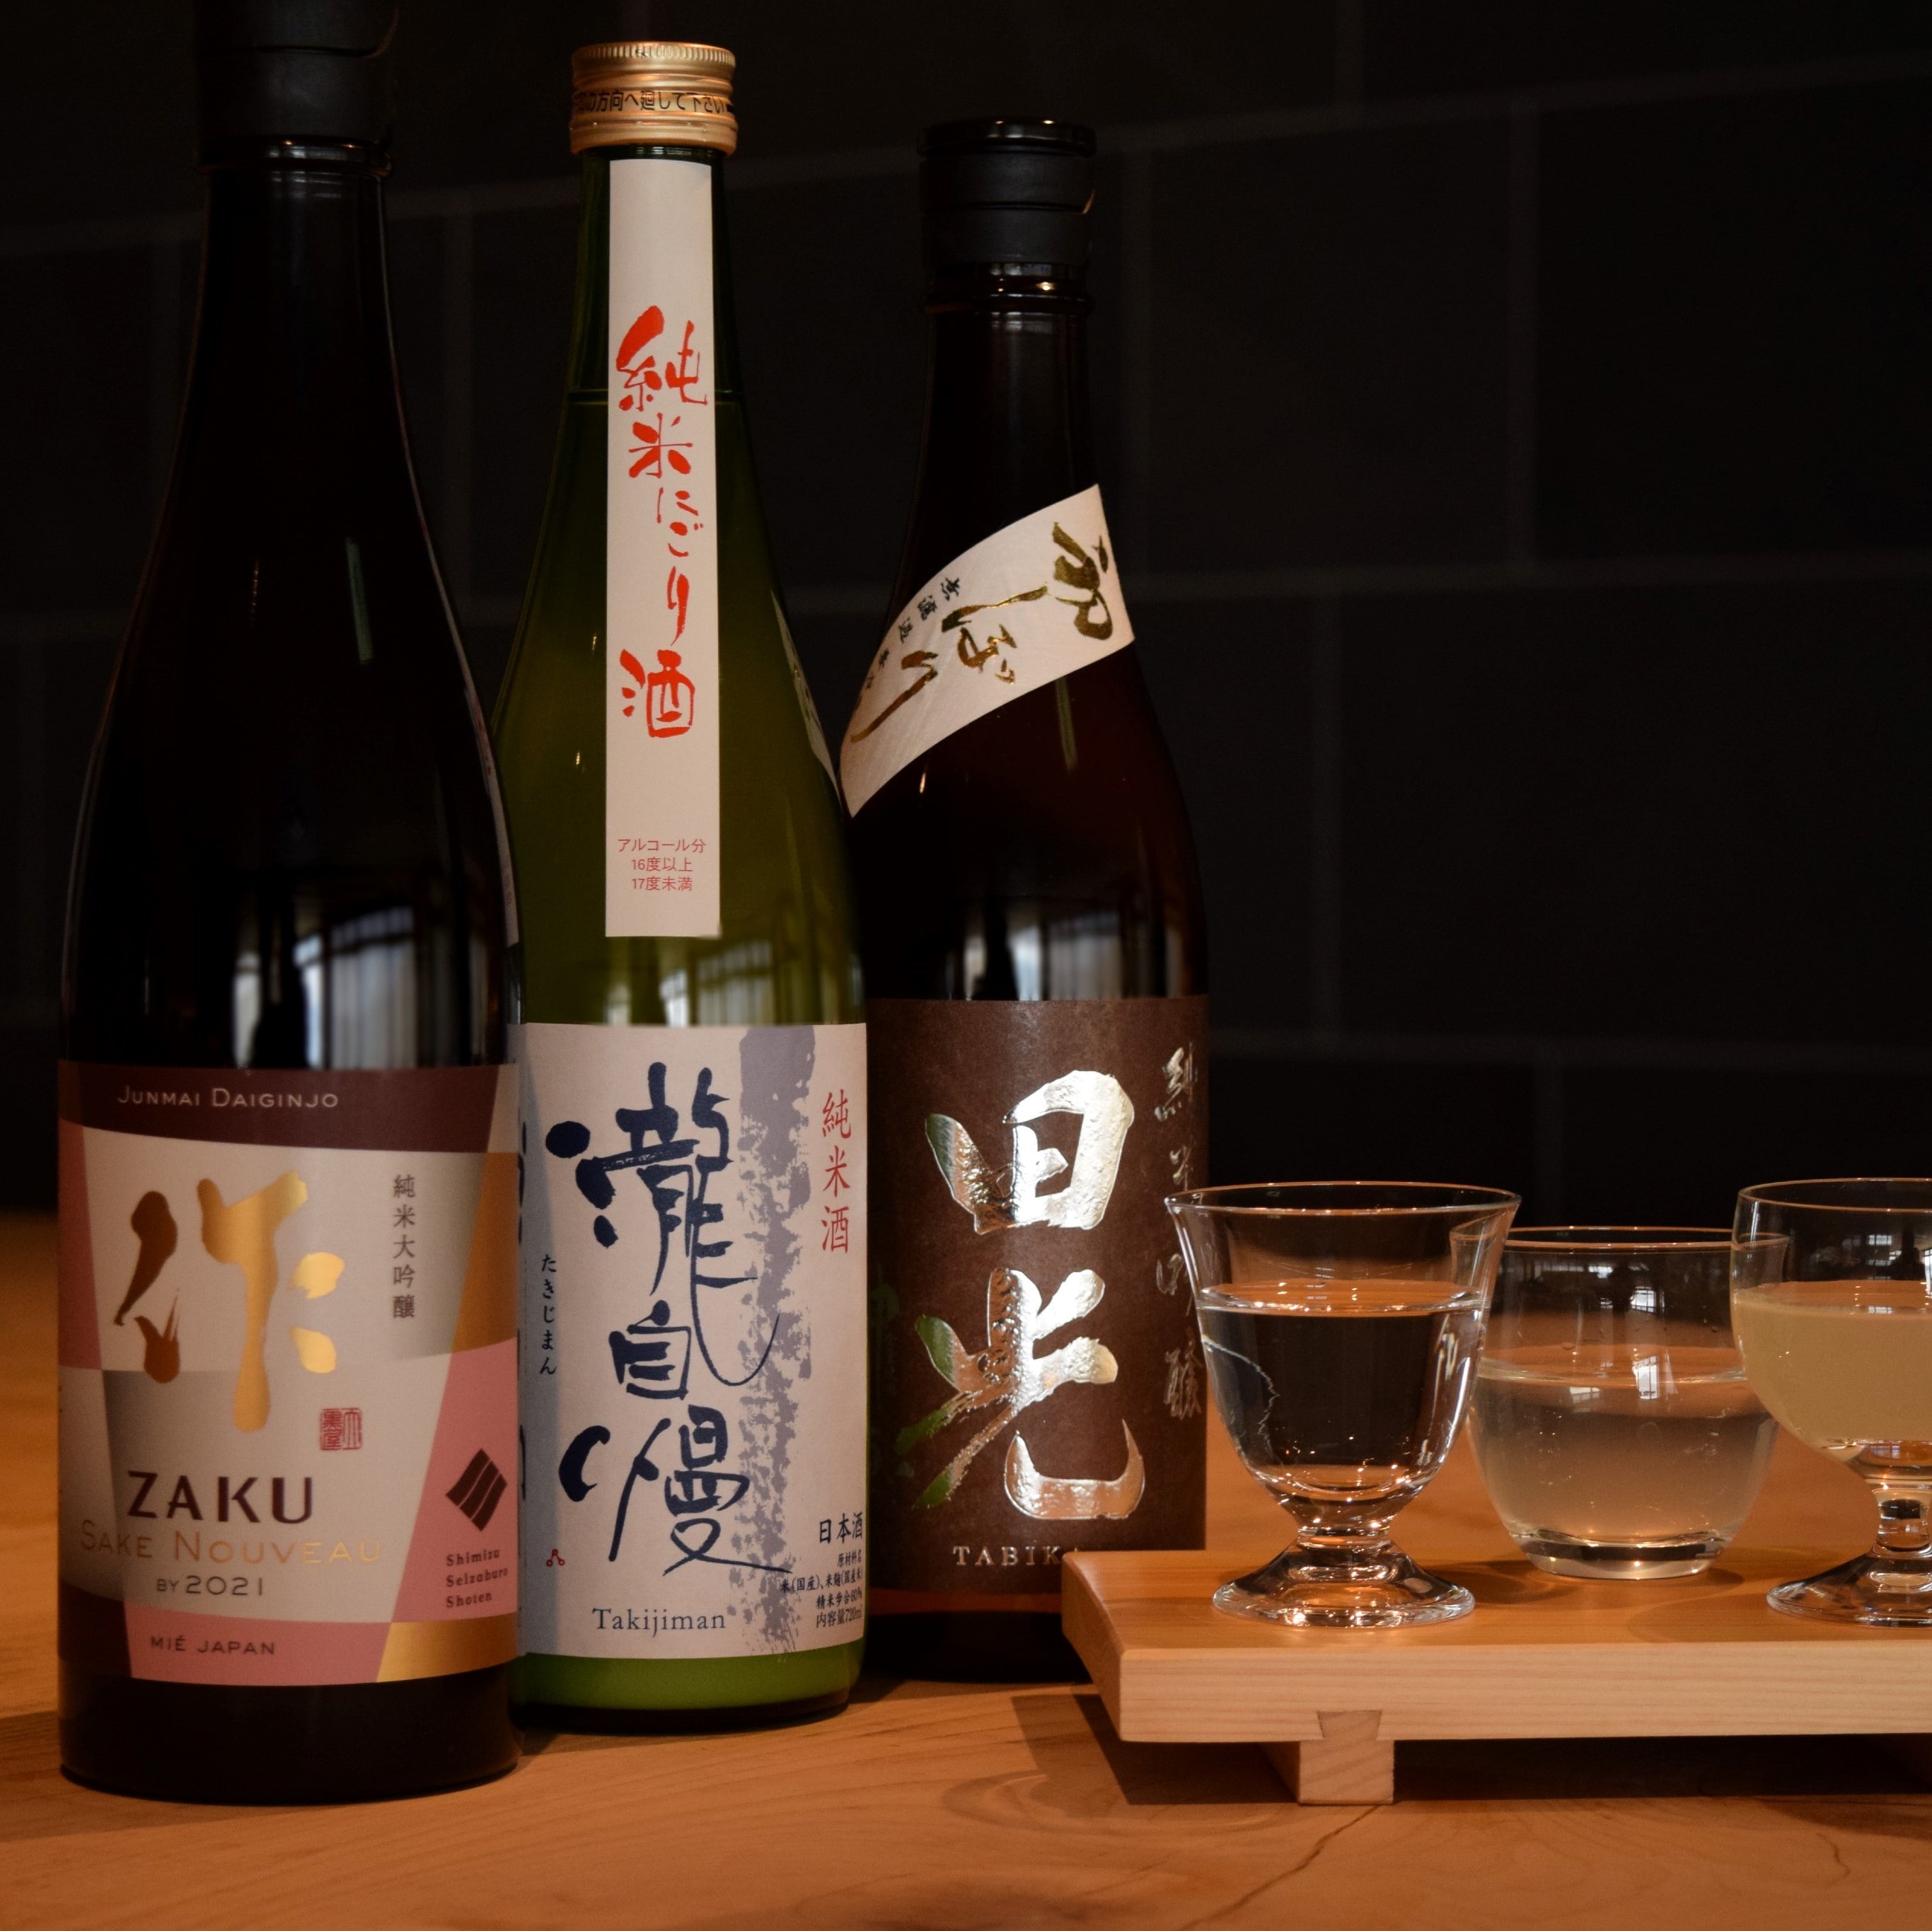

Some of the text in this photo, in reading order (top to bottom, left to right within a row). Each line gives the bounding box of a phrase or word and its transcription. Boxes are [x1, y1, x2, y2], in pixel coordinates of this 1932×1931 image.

[616, 306, 709, 738] 純米にごり酒
[618, 838, 707, 853] アルコール分
[632, 856, 693, 872] 16度以上
[632, 876, 693, 891] 17度未満
[820, 1090, 852, 1255] 純米酒
[393, 1174, 416, 1318] 純米大吟醸
[538, 1253, 558, 1376] たきじまん
[127, 1471, 313, 1524] ZAKU
[819, 1511, 863, 1545] 日本酒
[446, 1549, 500, 1567] Shimizu
[953, 1544, 1079, 1566] TABIK
[446, 1568, 509, 1587] Seizaburo
[446, 1593, 492, 1608] Shoten
[592, 1607, 727, 1638] Takijiman
[151, 1635, 275, 1655] MIÉ JAPAN
